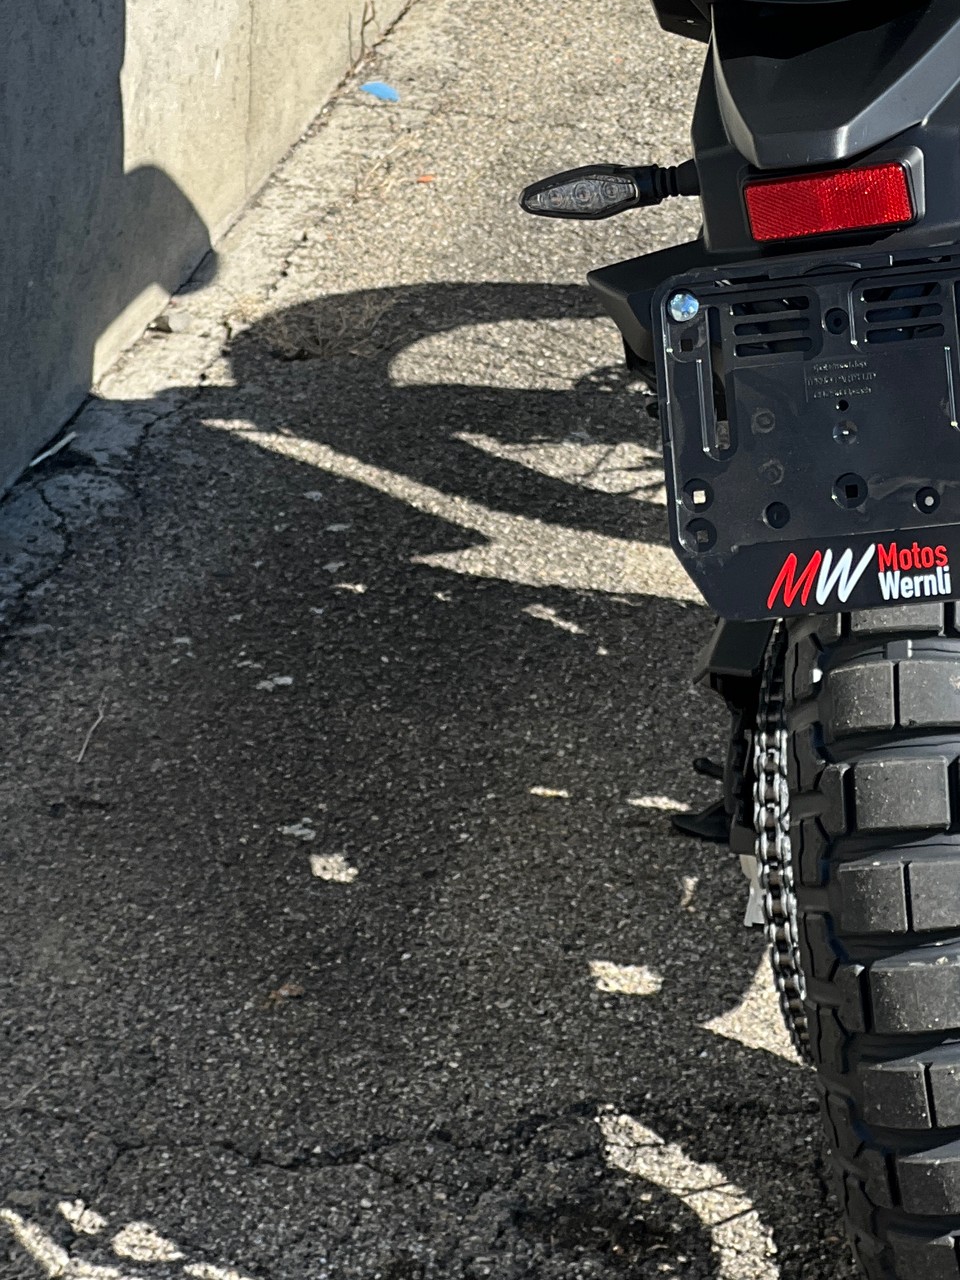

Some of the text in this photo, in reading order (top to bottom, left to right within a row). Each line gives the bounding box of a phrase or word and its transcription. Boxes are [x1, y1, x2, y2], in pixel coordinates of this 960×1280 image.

[877, 542, 949, 572] Motos
[766, 543, 876, 609] MW
[878, 565, 952, 601] Wernli
